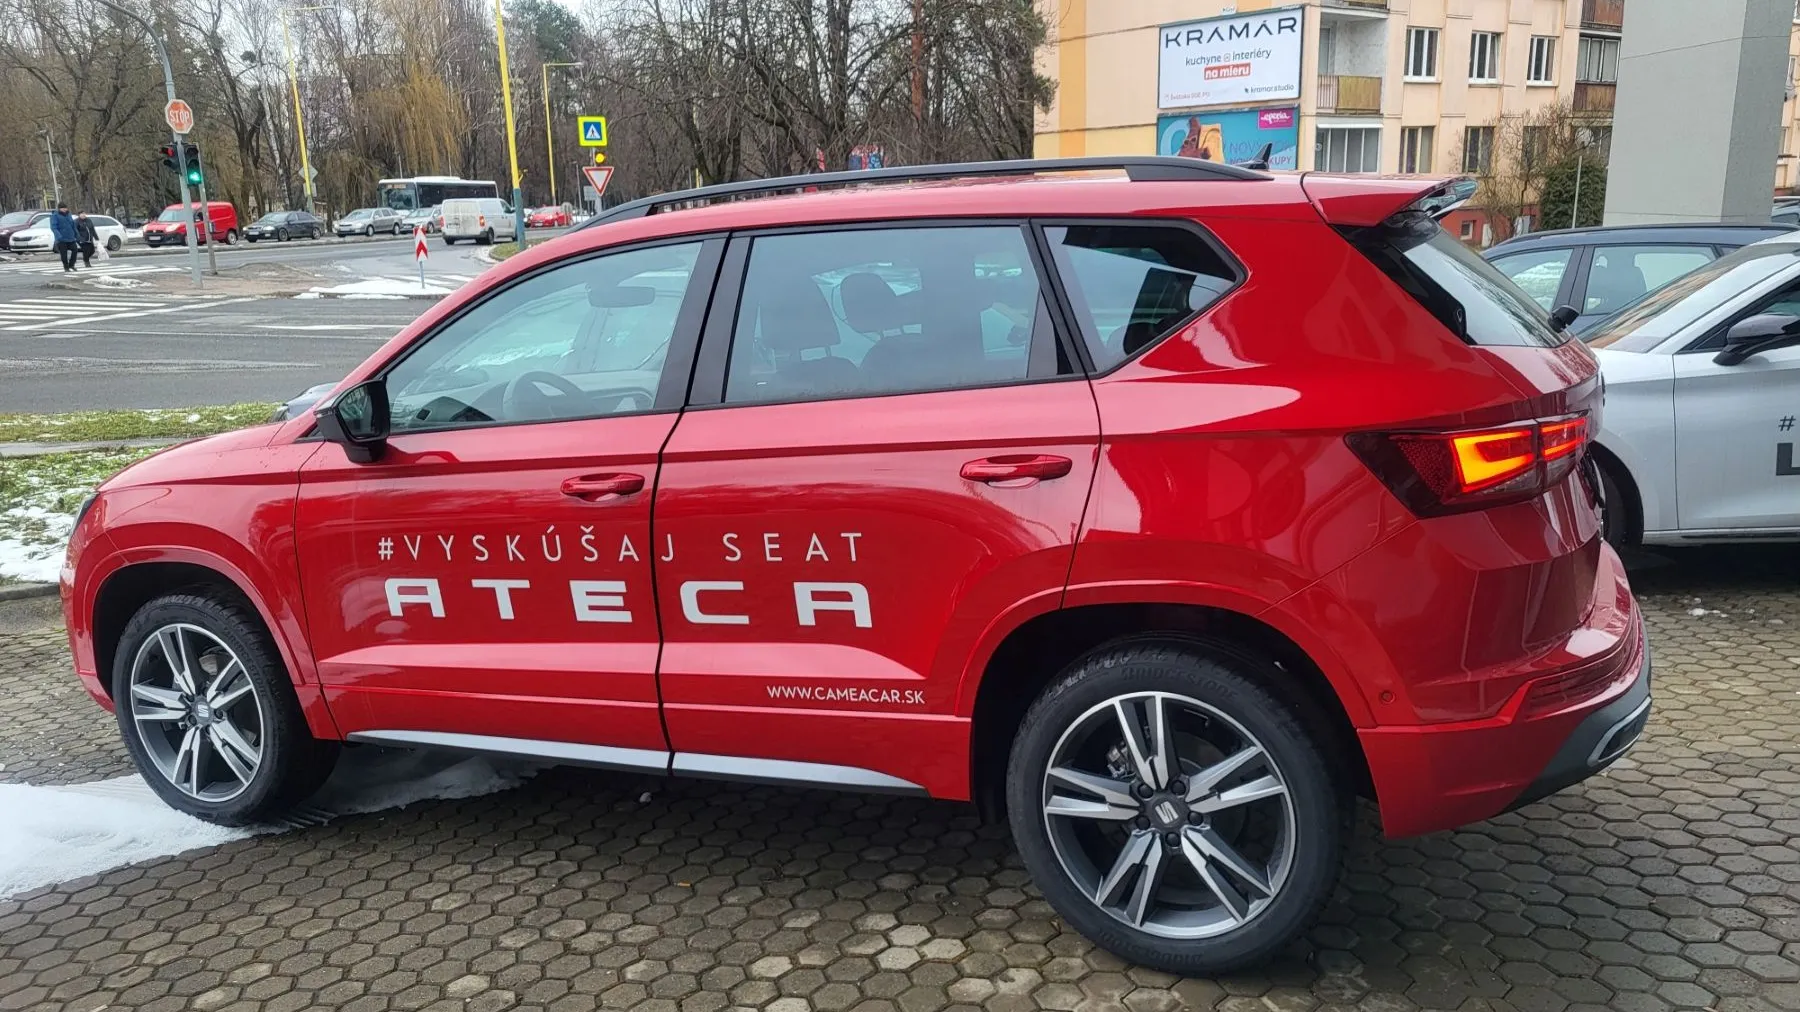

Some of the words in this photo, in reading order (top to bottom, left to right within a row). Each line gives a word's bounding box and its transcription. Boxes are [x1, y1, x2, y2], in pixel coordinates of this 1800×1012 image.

[1185, 53, 1222, 67] kuchyne
[1232, 47, 1272, 62] interiéry
[1205, 69, 1218, 79] na
[1219, 64, 1249, 77] mieru
[169, 109, 190, 123] STOP
[378, 524, 674, 562] #VYSKÚŠAJ
[723, 532, 862, 562] SEAT
[384, 578, 872, 628] ATECA
[766, 685, 925, 706] WWW.CAMEACAR.SK
